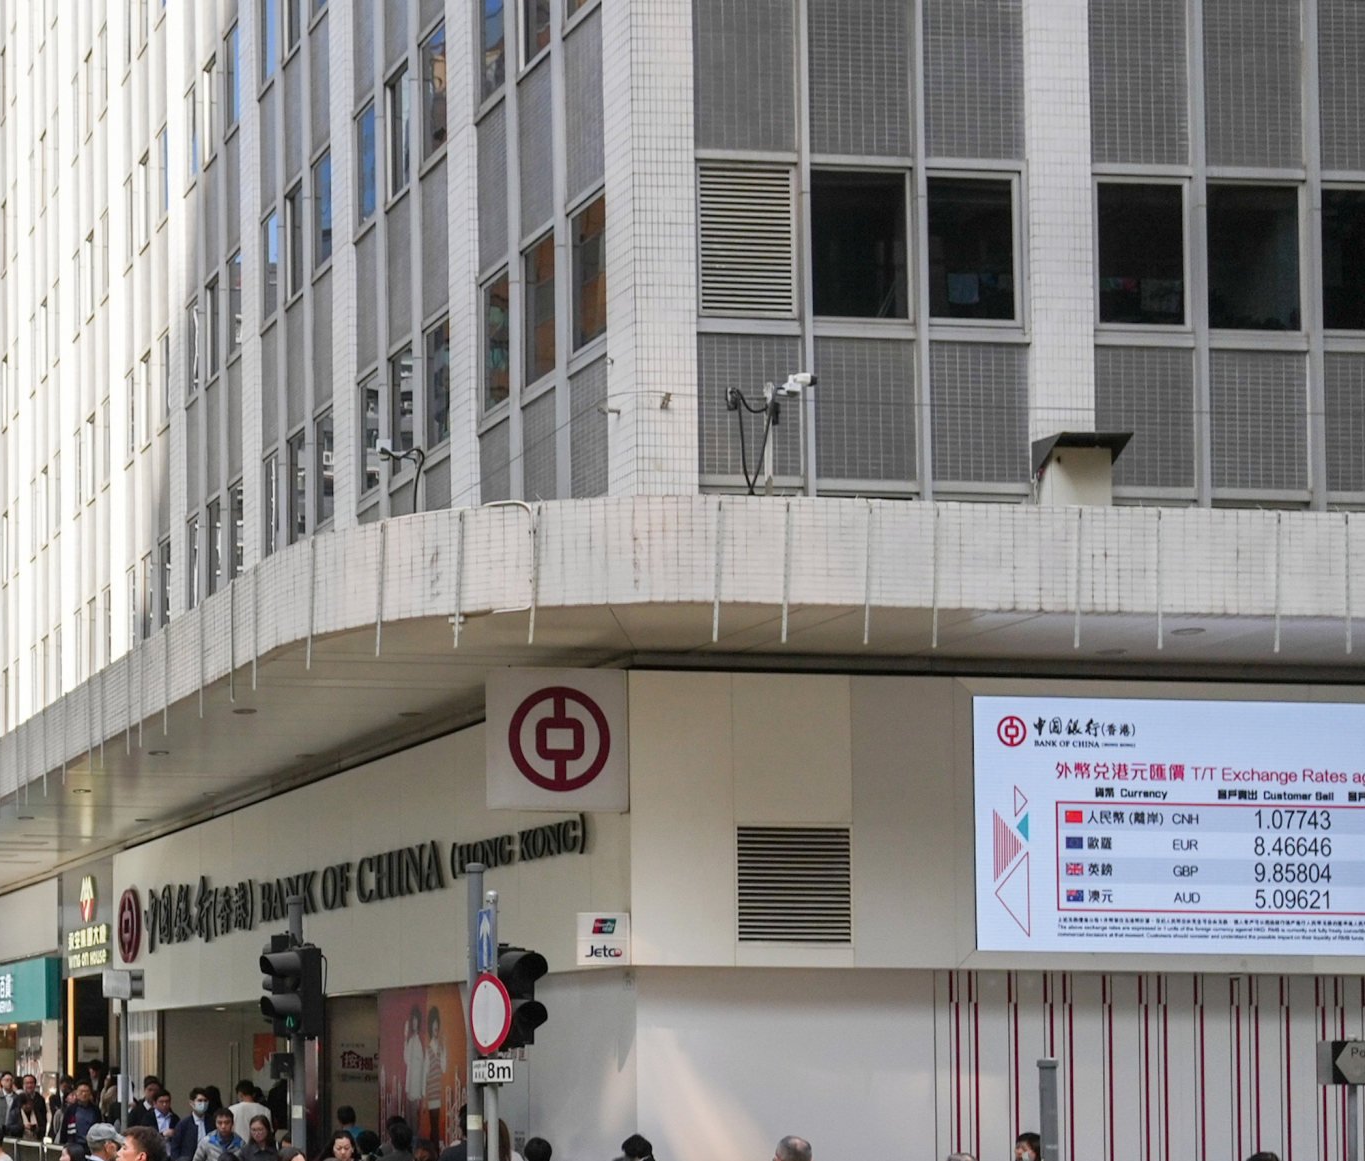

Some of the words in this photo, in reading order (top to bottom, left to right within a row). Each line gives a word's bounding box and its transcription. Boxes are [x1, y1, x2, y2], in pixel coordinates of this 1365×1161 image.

[1034, 739, 1058, 748] BANK
[1059, 740, 1070, 748] OF
[1072, 740, 1100, 749] CHINA
[1222, 768, 1298, 785] Exchange
[1302, 769, 1348, 783] Rates
[1120, 788, 1168, 801] Currency
[1087, 811, 1125, 825] 人民幣
[1171, 813, 1200, 825] CNH
[1254, 809, 1332, 830] 1.07743
[1172, 839, 1199, 851] EUR
[1254, 836, 1332, 857] 8.46646
[258, 870, 318, 923] BANK
[320, 861, 354, 911] OF
[356, 839, 447, 904] CHINA
[451, 833, 515, 880] (HONG
[517, 812, 587, 862] KONG)
[1173, 865, 1199, 877] GBP
[1254, 863, 1332, 884] 9.85804
[1088, 890, 1114, 904] 澳元
[1173, 892, 1202, 904] AUD
[1254, 890, 1331, 910] 5.09621
[487, 1062, 511, 1080] 8m
